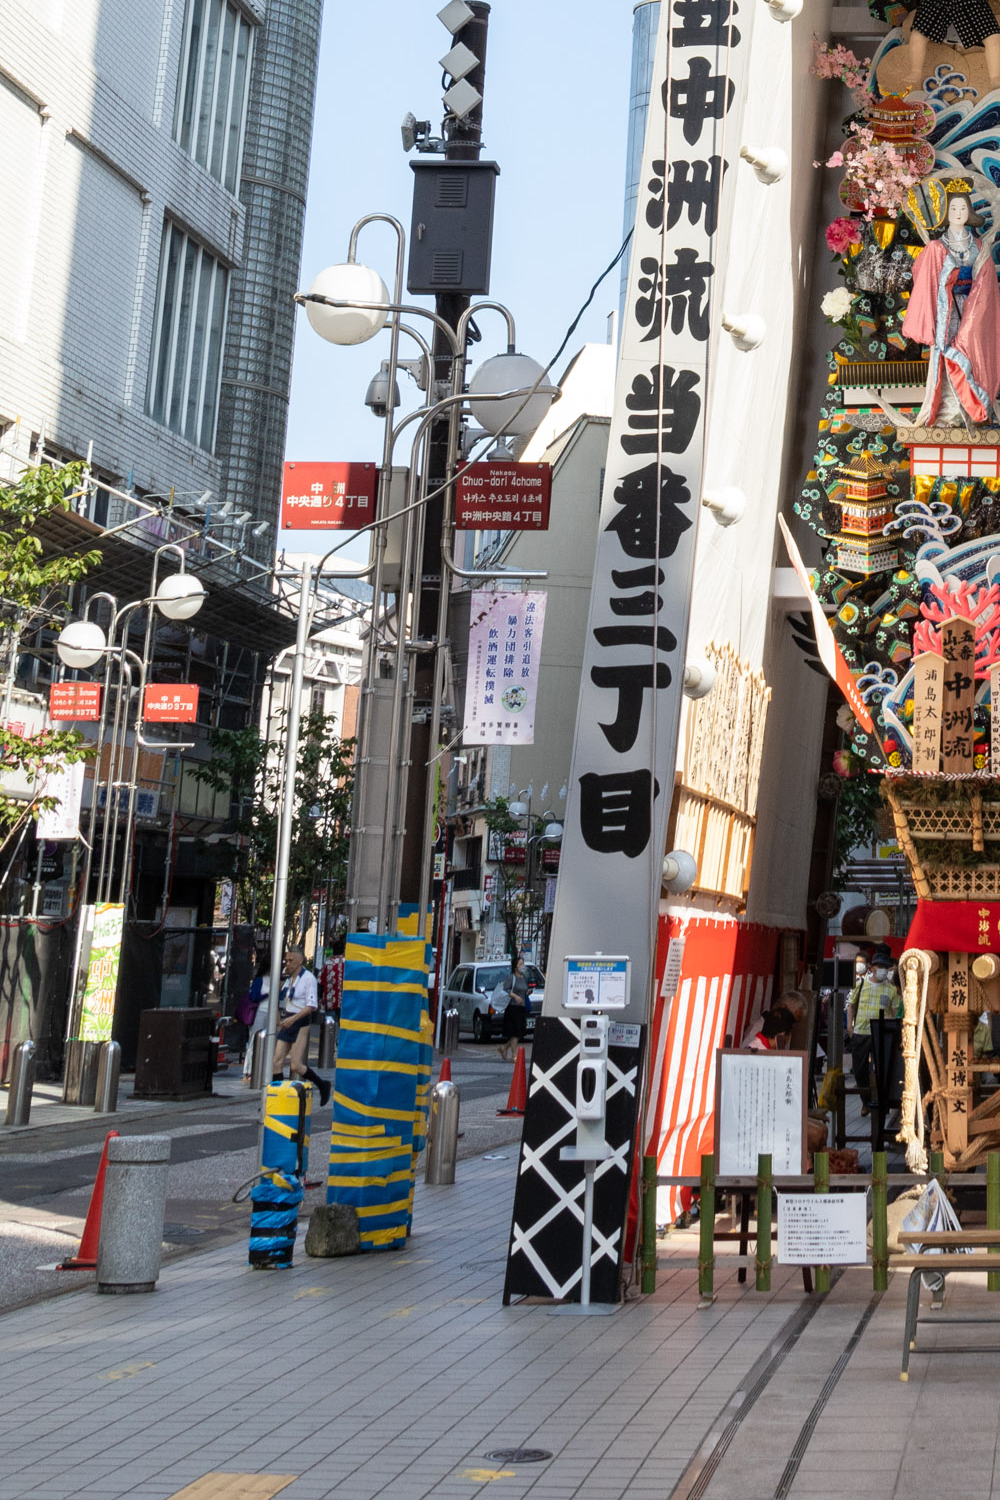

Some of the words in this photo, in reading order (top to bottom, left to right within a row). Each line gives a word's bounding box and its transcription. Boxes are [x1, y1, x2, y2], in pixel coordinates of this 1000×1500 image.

[286, 495, 369, 508] 中央通り4丁目
[462, 476, 508, 486] Chuo-dori
[511, 476, 542, 486] 4chome
[461, 511, 542, 522] 中洲中央路4丁目
[484, 628, 499, 705] 飲酒運転撲滅
[503, 615, 518, 678] 暴力団排除
[521, 601, 536, 678] 違法客引追放
[944, 672, 973, 759] 中洲流
